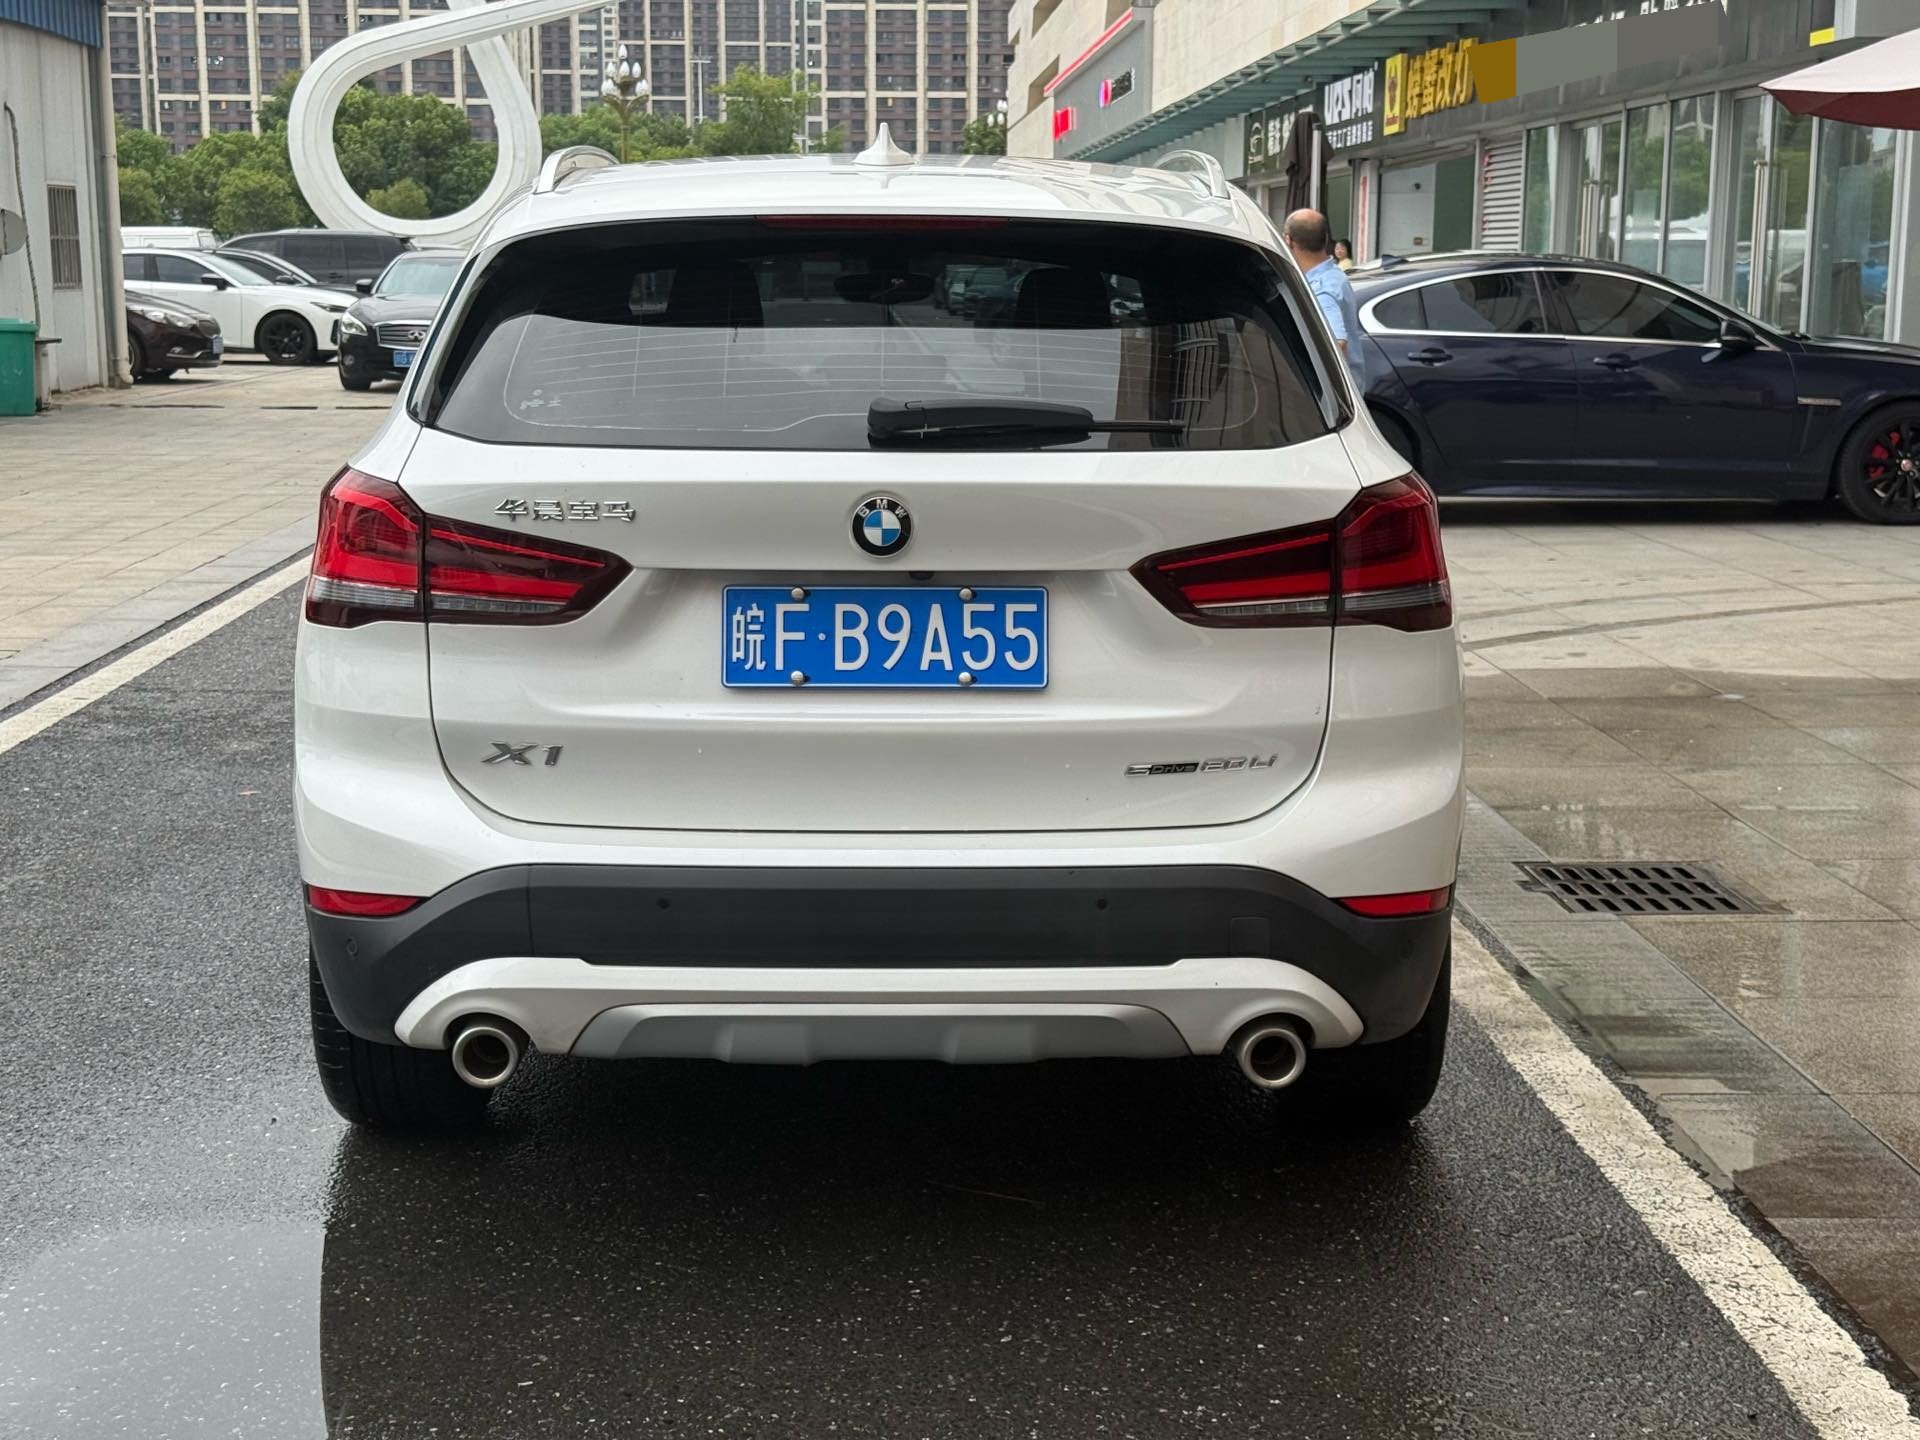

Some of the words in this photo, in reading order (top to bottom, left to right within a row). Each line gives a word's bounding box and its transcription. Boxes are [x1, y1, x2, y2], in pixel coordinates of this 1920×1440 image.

[494, 499, 635, 522] 华晨宝马
[857, 499, 908, 519] BMW
[481, 741, 563, 766] X1
